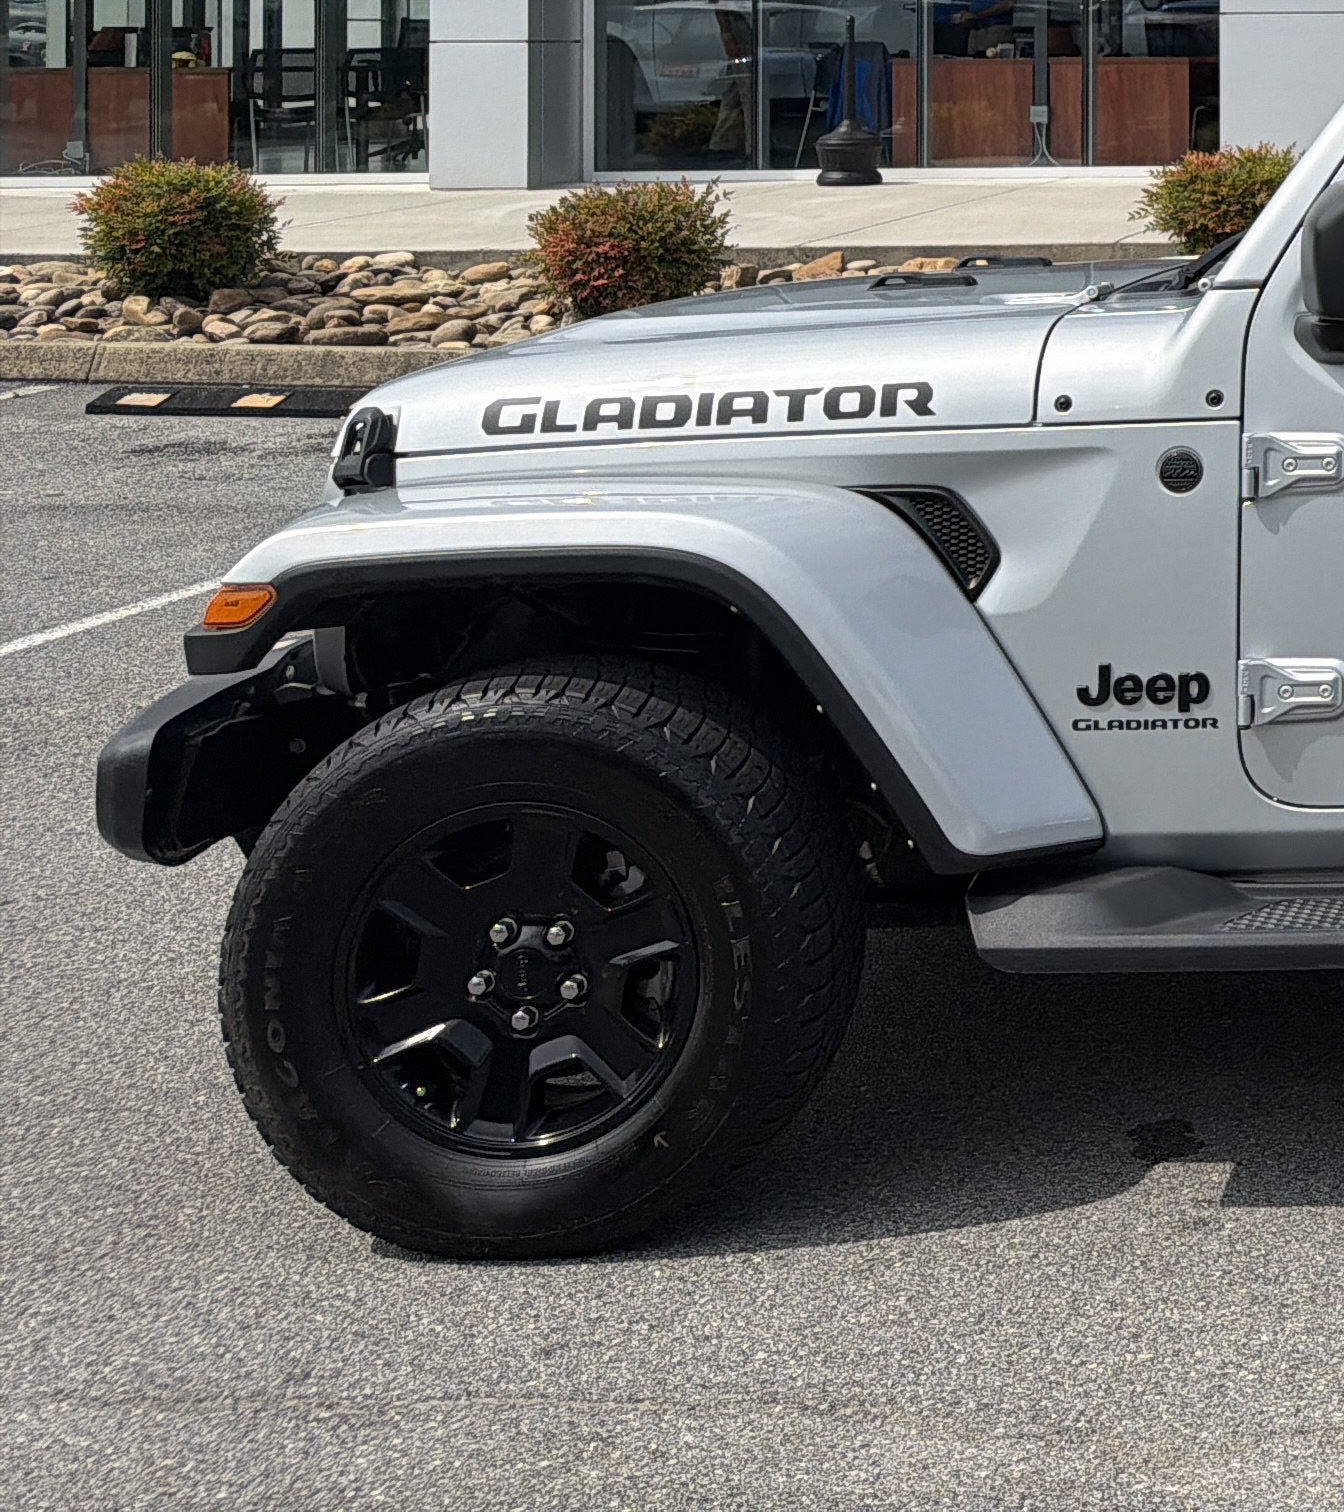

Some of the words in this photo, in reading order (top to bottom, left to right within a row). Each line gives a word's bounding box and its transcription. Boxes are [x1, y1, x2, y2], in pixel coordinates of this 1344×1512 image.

[481, 381, 936, 435] GLADIATOR
[1076, 663, 1211, 713] Jeep
[1071, 717, 1219, 732] GLADIATOR
